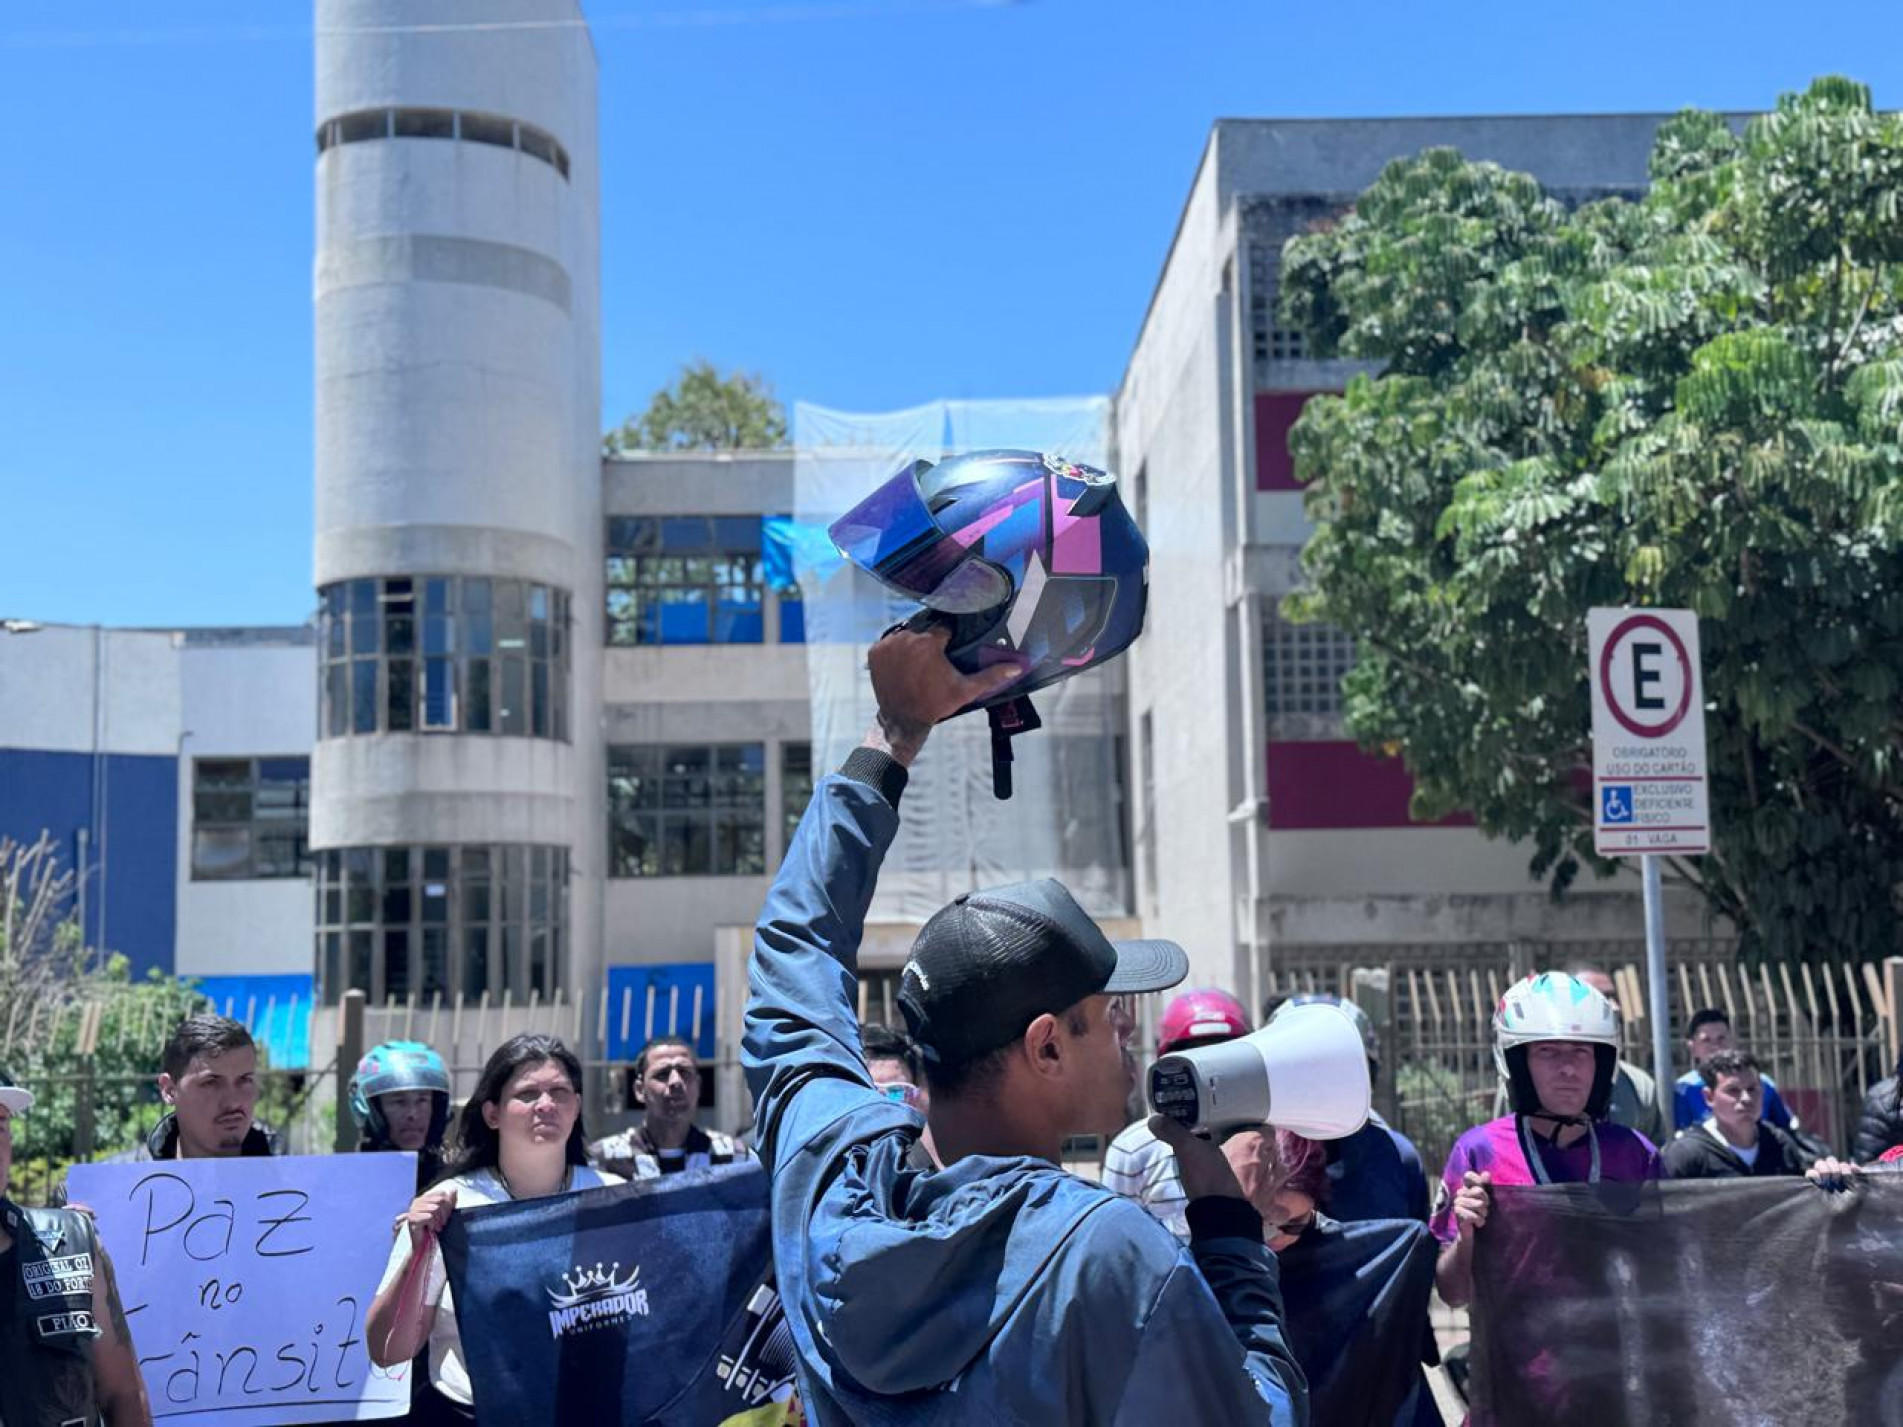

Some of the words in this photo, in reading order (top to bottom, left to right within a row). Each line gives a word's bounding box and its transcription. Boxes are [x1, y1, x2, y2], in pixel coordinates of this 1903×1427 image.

[1631, 642, 1666, 710] E
[1606, 763, 1630, 774] USO
[1633, 763, 1650, 774] DO
[1647, 834, 1678, 845] VAGA
[129, 1172, 314, 1265] Paz
[199, 1278, 243, 1310] no
[548, 1288, 649, 1340] IMPERADOR
